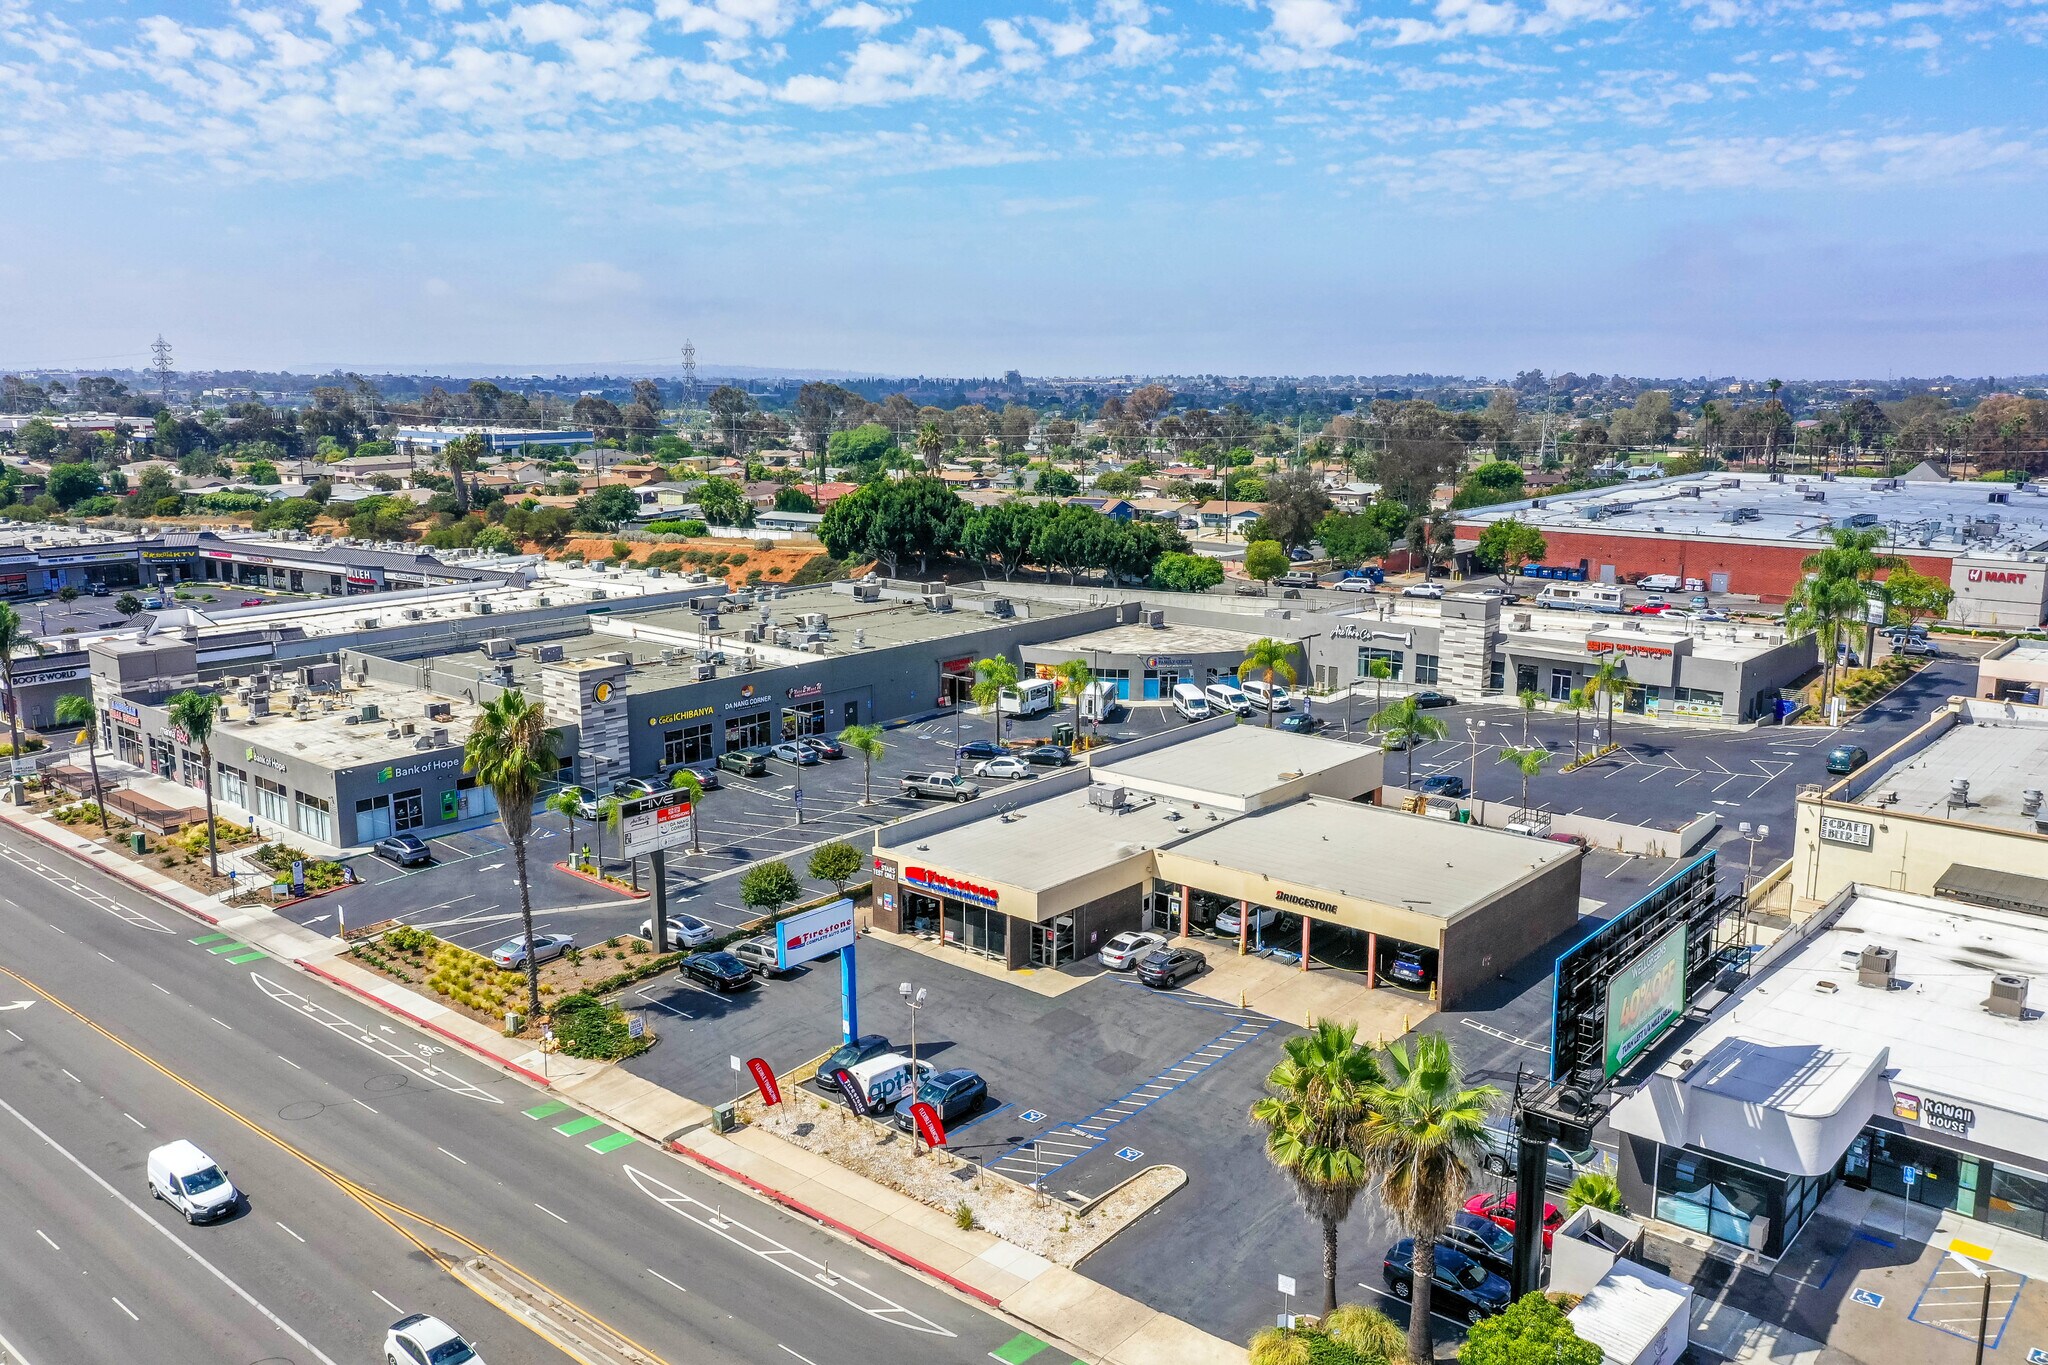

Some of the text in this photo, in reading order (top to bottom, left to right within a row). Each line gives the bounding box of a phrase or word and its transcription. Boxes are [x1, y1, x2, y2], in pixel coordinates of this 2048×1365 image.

[1969, 569, 2026, 585] H MART
[12, 670, 77, 685] BOOT WORLD
[733, 699, 749, 708] NANG
[749, 695, 772, 705] CORNER
[673, 707, 714, 722] ICHIBANYA
[395, 758, 459, 778] Bank of Hope
[640, 793, 674, 811] HIVE
[1827, 828, 1853, 842] BEER
[925, 869, 999, 901] Firestone
[1275, 890, 1339, 914] BRIDGESTONE
[801, 918, 852, 943] Firestone
[805, 935, 828, 946] COMPLETE
[1631, 943, 1667, 979] WELLGREENS
[844, 1078, 865, 1113] Firestone
[1924, 1098, 1974, 1124] KAWAII
[1927, 1114, 1966, 1134] HOUSE
[1931, 1319, 1942, 1327] NO
